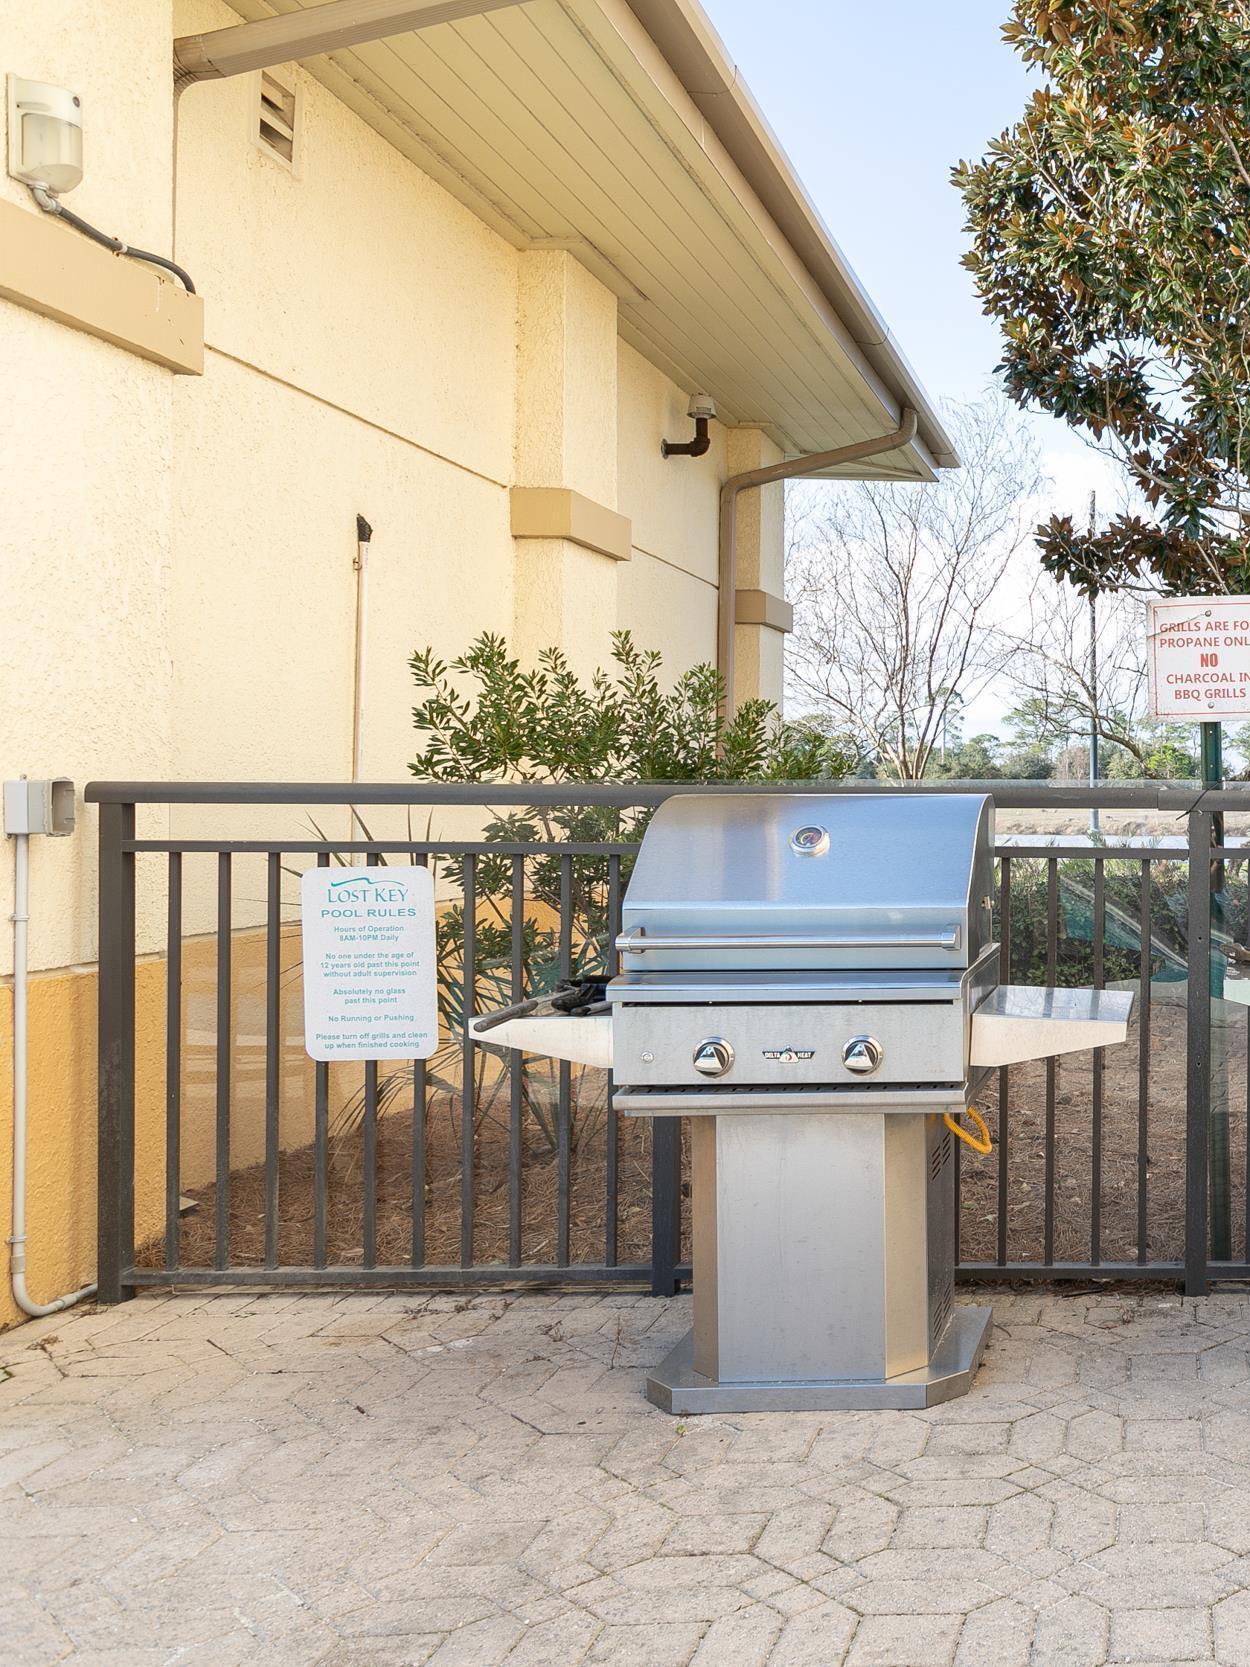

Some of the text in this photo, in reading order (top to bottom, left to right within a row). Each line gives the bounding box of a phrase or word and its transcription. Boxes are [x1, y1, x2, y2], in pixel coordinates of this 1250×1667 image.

[1160, 621, 1201, 633] GRILLS
[1205, 621, 1229, 632] ARE
[1160, 637, 1220, 648] PROPANE
[1200, 653, 1219, 667] NO
[1166, 672, 1236, 684] CHARCOAL
[1174, 688, 1247, 702] BBQ GRILLS
[328, 888, 409, 903] LOST KEY
[321, 908, 417, 918] POOL RULES
[368, 925, 404, 933] Operation
[381, 934, 400, 942] Daily
[401, 961, 420, 969] point
[323, 970, 351, 978] without
[373, 969, 417, 977] supervision
[333, 988, 372, 996] Absolutely
[386, 987, 406, 995] glass
[378, 997, 398, 1005] point
[340, 1015, 372, 1023] Running
[383, 1014, 414, 1022] Pushing
[371, 1032, 390, 1040] grills
[407, 1031, 428, 1039] clean
[389, 1040, 420, 1049] cooking
